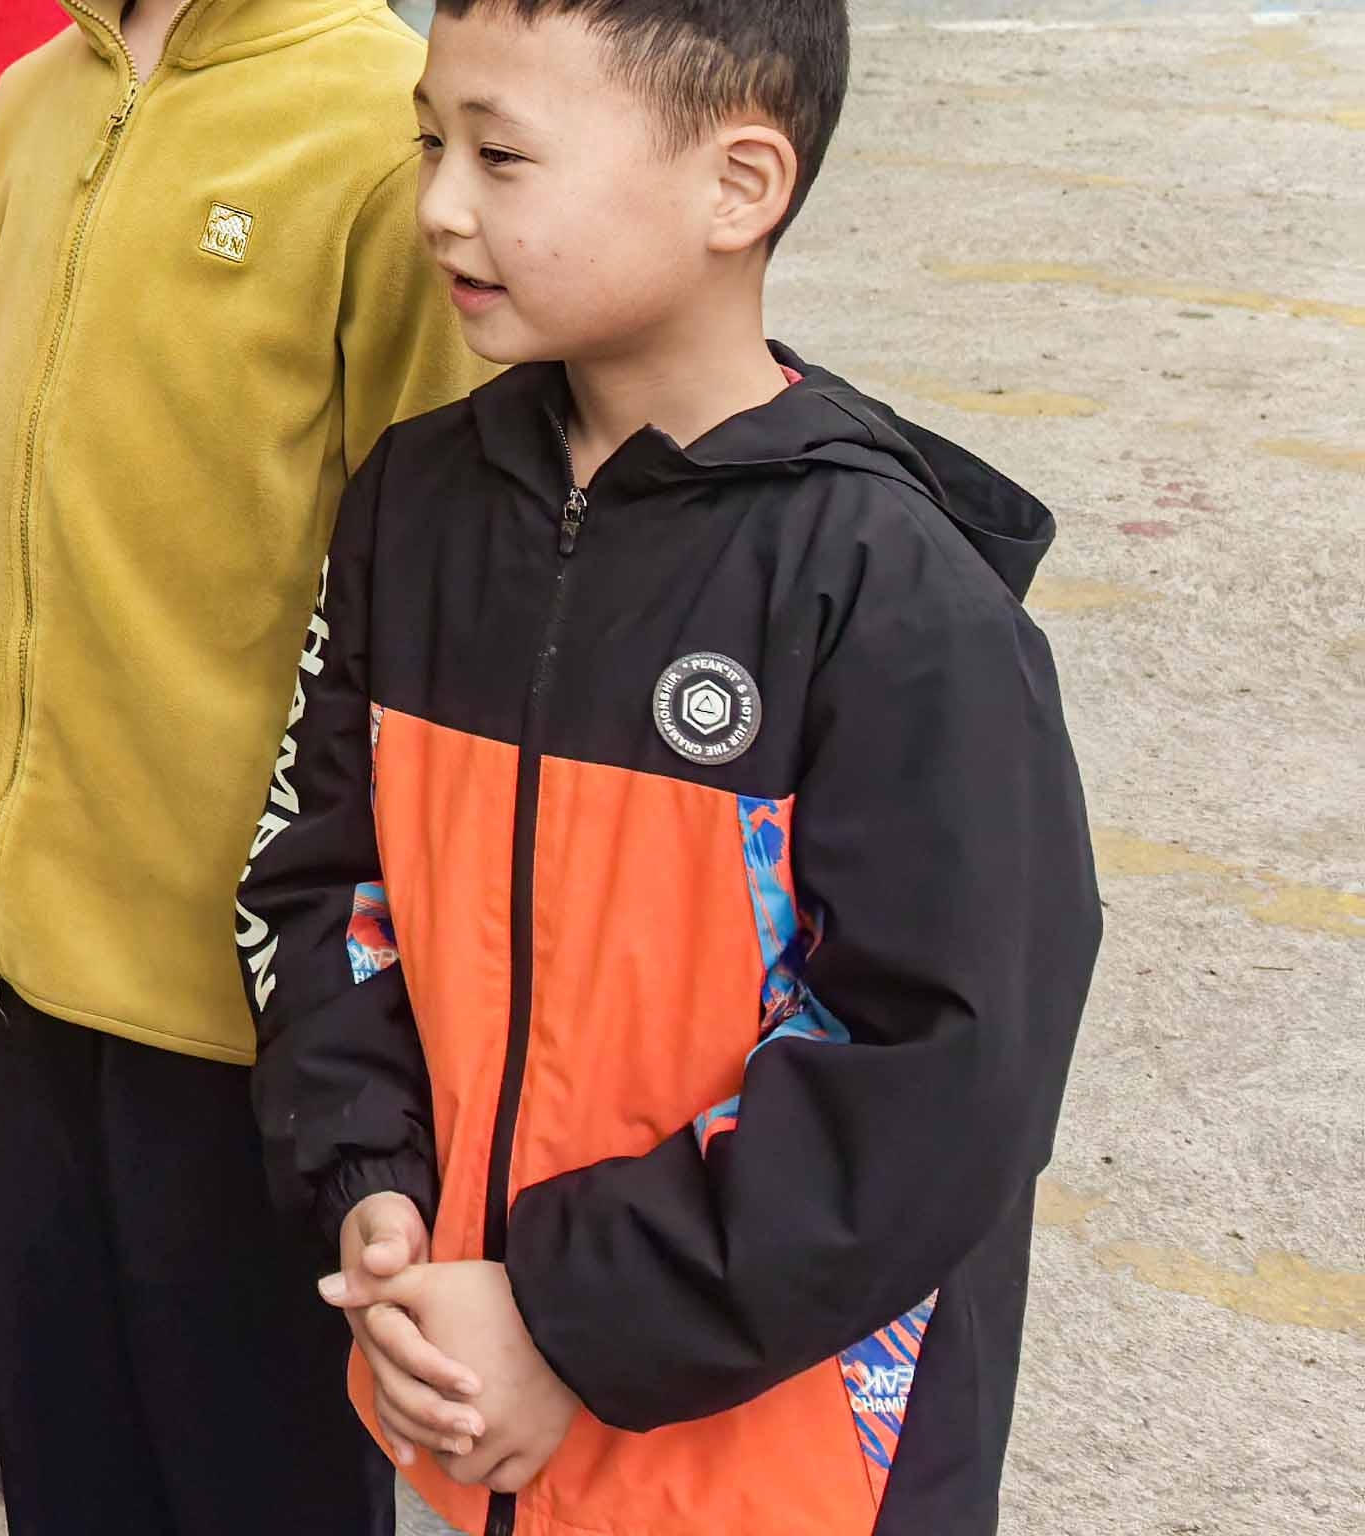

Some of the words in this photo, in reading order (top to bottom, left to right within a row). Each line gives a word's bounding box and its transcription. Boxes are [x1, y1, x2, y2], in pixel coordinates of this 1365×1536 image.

[691, 658, 725, 673] PEAK
[740, 696, 752, 723] NOT
[705, 742, 730, 756] THE
